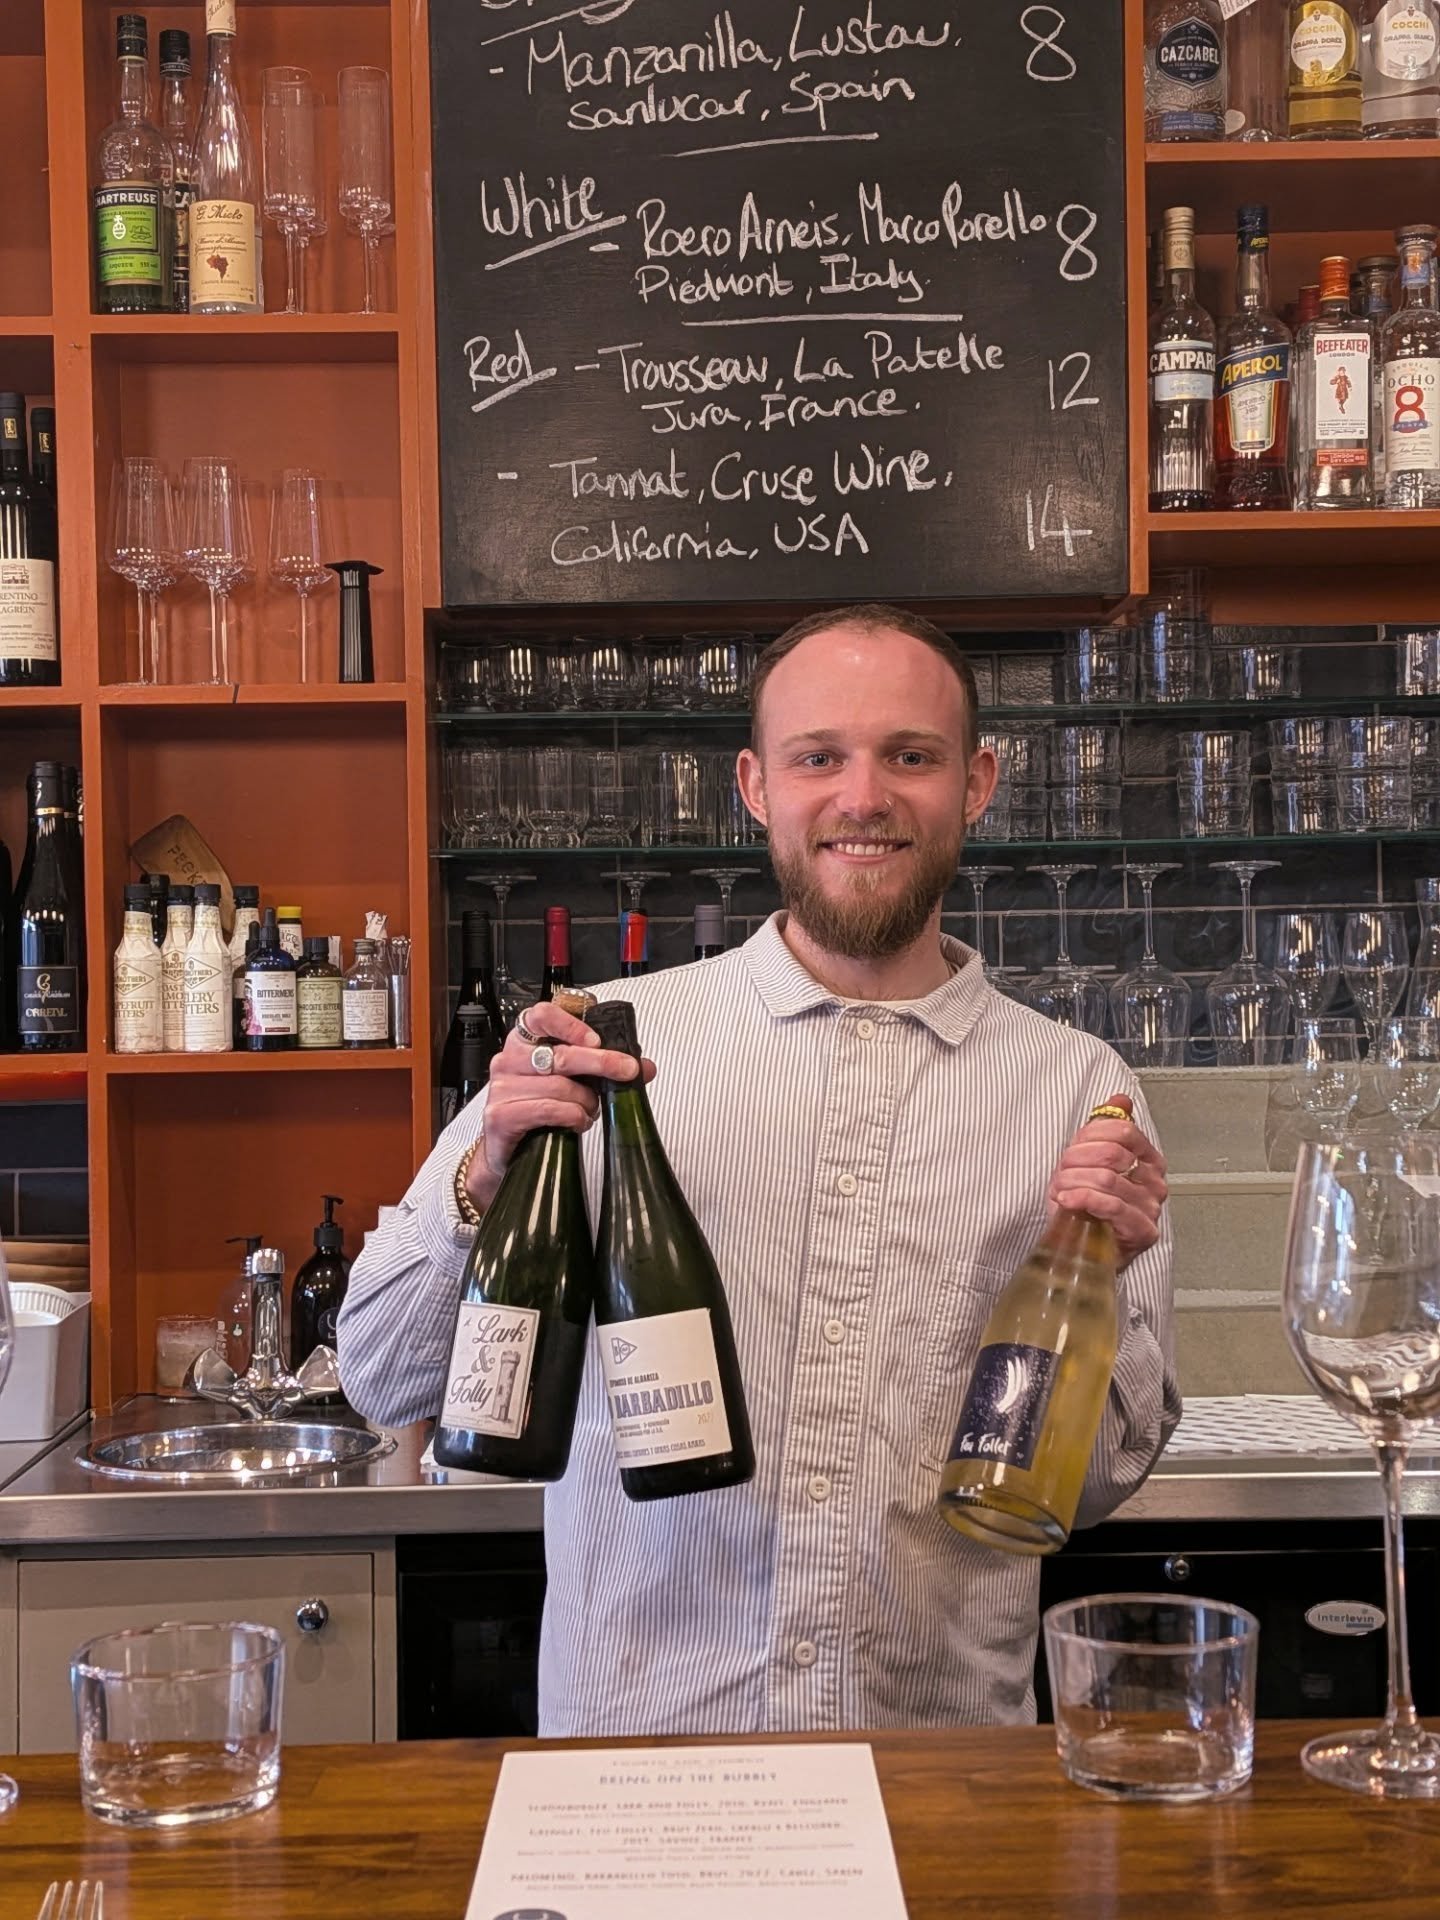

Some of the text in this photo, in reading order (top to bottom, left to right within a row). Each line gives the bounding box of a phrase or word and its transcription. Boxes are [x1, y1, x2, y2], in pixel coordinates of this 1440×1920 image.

[1391, 20, 1429, 30] COCCHI
[528, 10, 782, 94] Manzanilla,
[1020, 6, 1077, 81] 8
[1160, 45, 1220, 65] CAZCABEL
[781, 71, 915, 131] Spain
[481, 171, 606, 238] White
[636, 198, 731, 260] Roero
[1056, 204, 1097, 281] 8
[1150, 350, 1216, 373] CAMPARI
[1316, 338, 1369, 355] BEEFEATER
[463, 329, 533, 392] Red
[794, 337, 854, 384] La
[1049, 351, 1099, 410] 12
[1221, 353, 1283, 388] APEROL
[1387, 374, 1435, 389] OCHO
[1394, 385, 1425, 434] 8
[549, 448, 704, 504] Tannat,
[711, 452, 817, 506] Cruse
[774, 511, 869, 557] USA
[1025, 483, 1093, 559] 14
[472, 1314, 528, 1344] Lark
[471, 1344, 496, 1374] &
[448, 1374, 494, 1412] Folly
